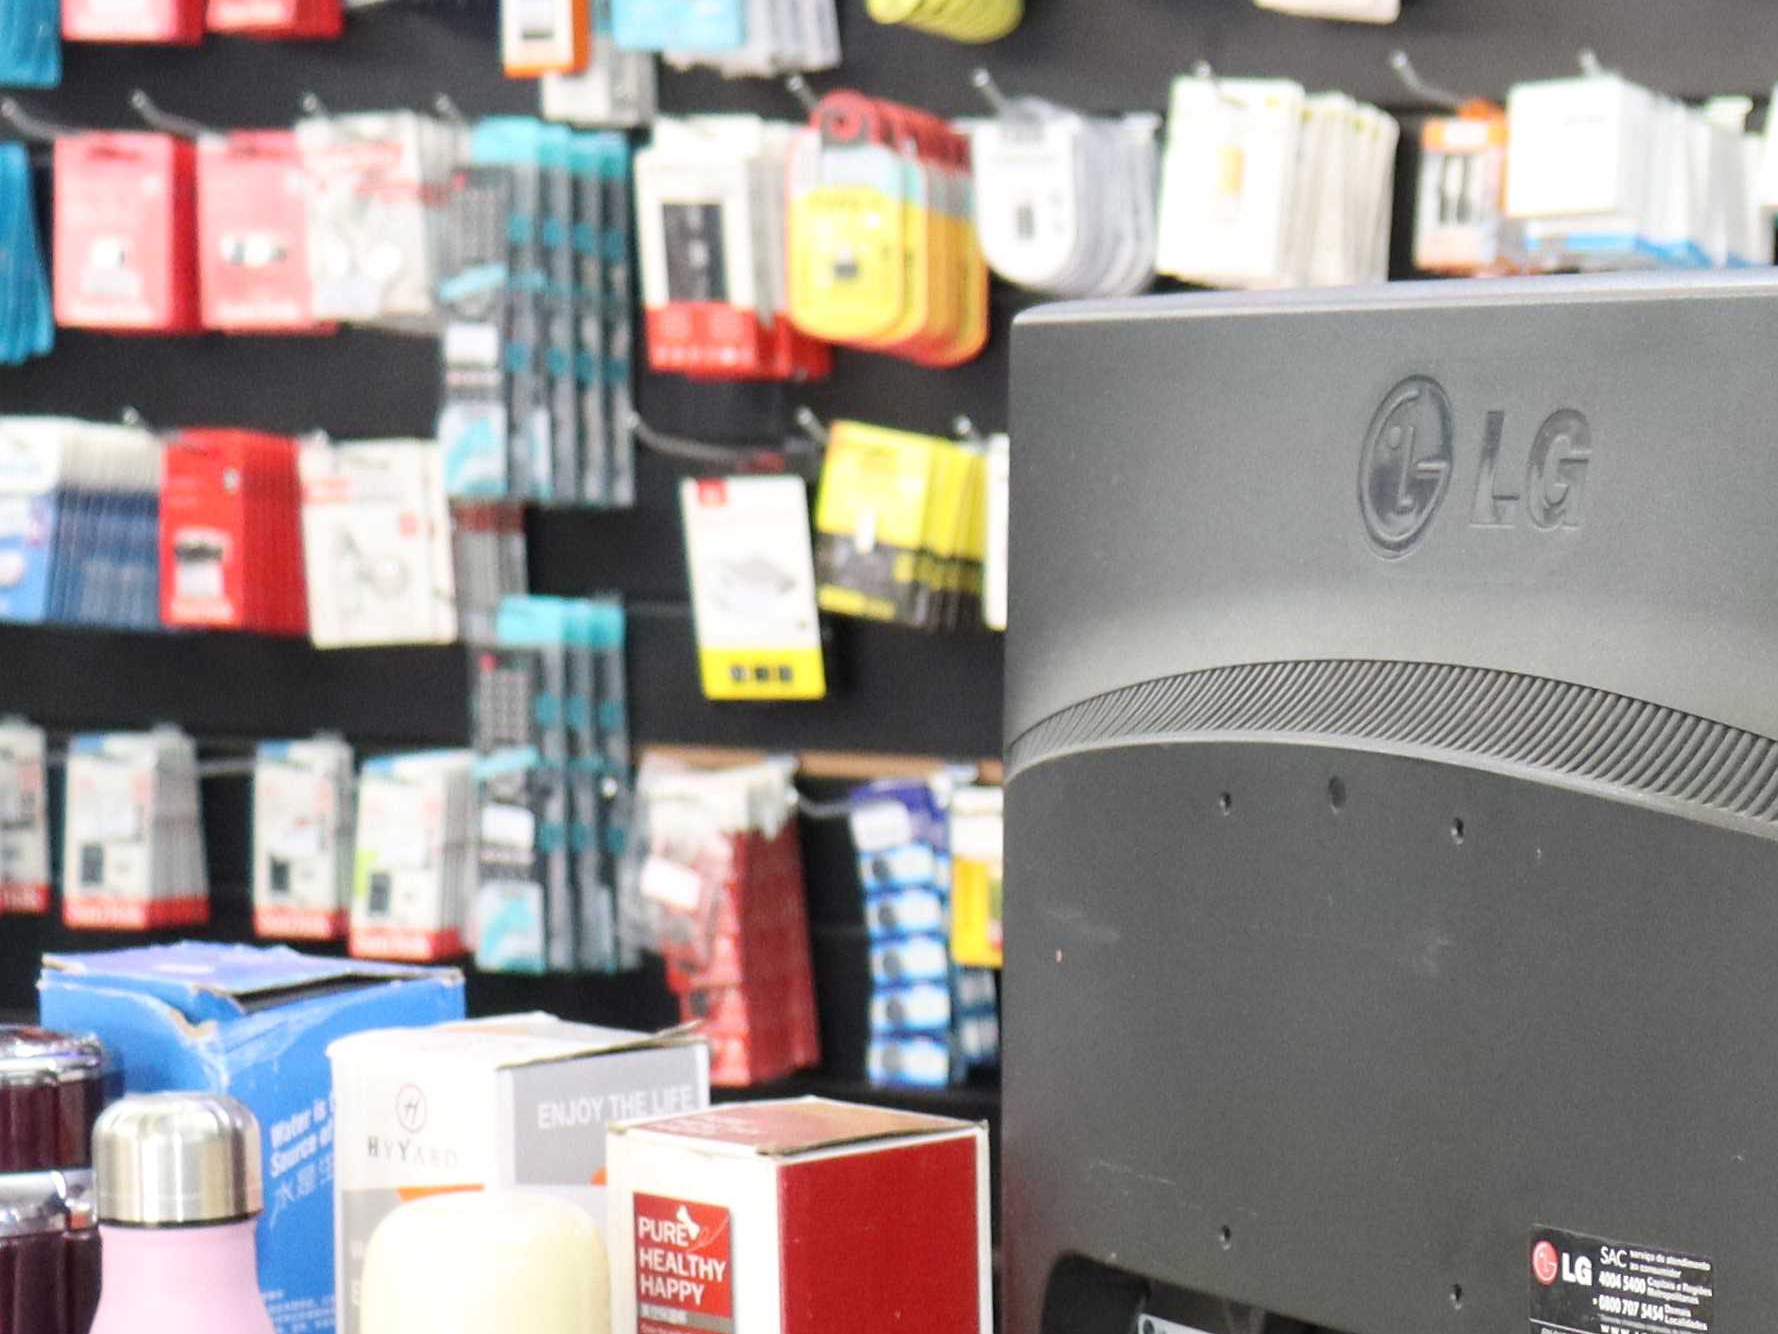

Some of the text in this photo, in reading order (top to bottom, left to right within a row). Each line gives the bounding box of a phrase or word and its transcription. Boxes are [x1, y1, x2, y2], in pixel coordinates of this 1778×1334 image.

[1469, 408, 1592, 531] LG
[536, 1084, 694, 1130] ENJOY THE LIFE
[638, 1216, 690, 1247] PURE
[638, 1245, 728, 1283] HEALTHY
[1561, 1252, 1593, 1287] LG
[1600, 1245, 1629, 1268] SAC
[639, 1273, 706, 1307] HAPPY
